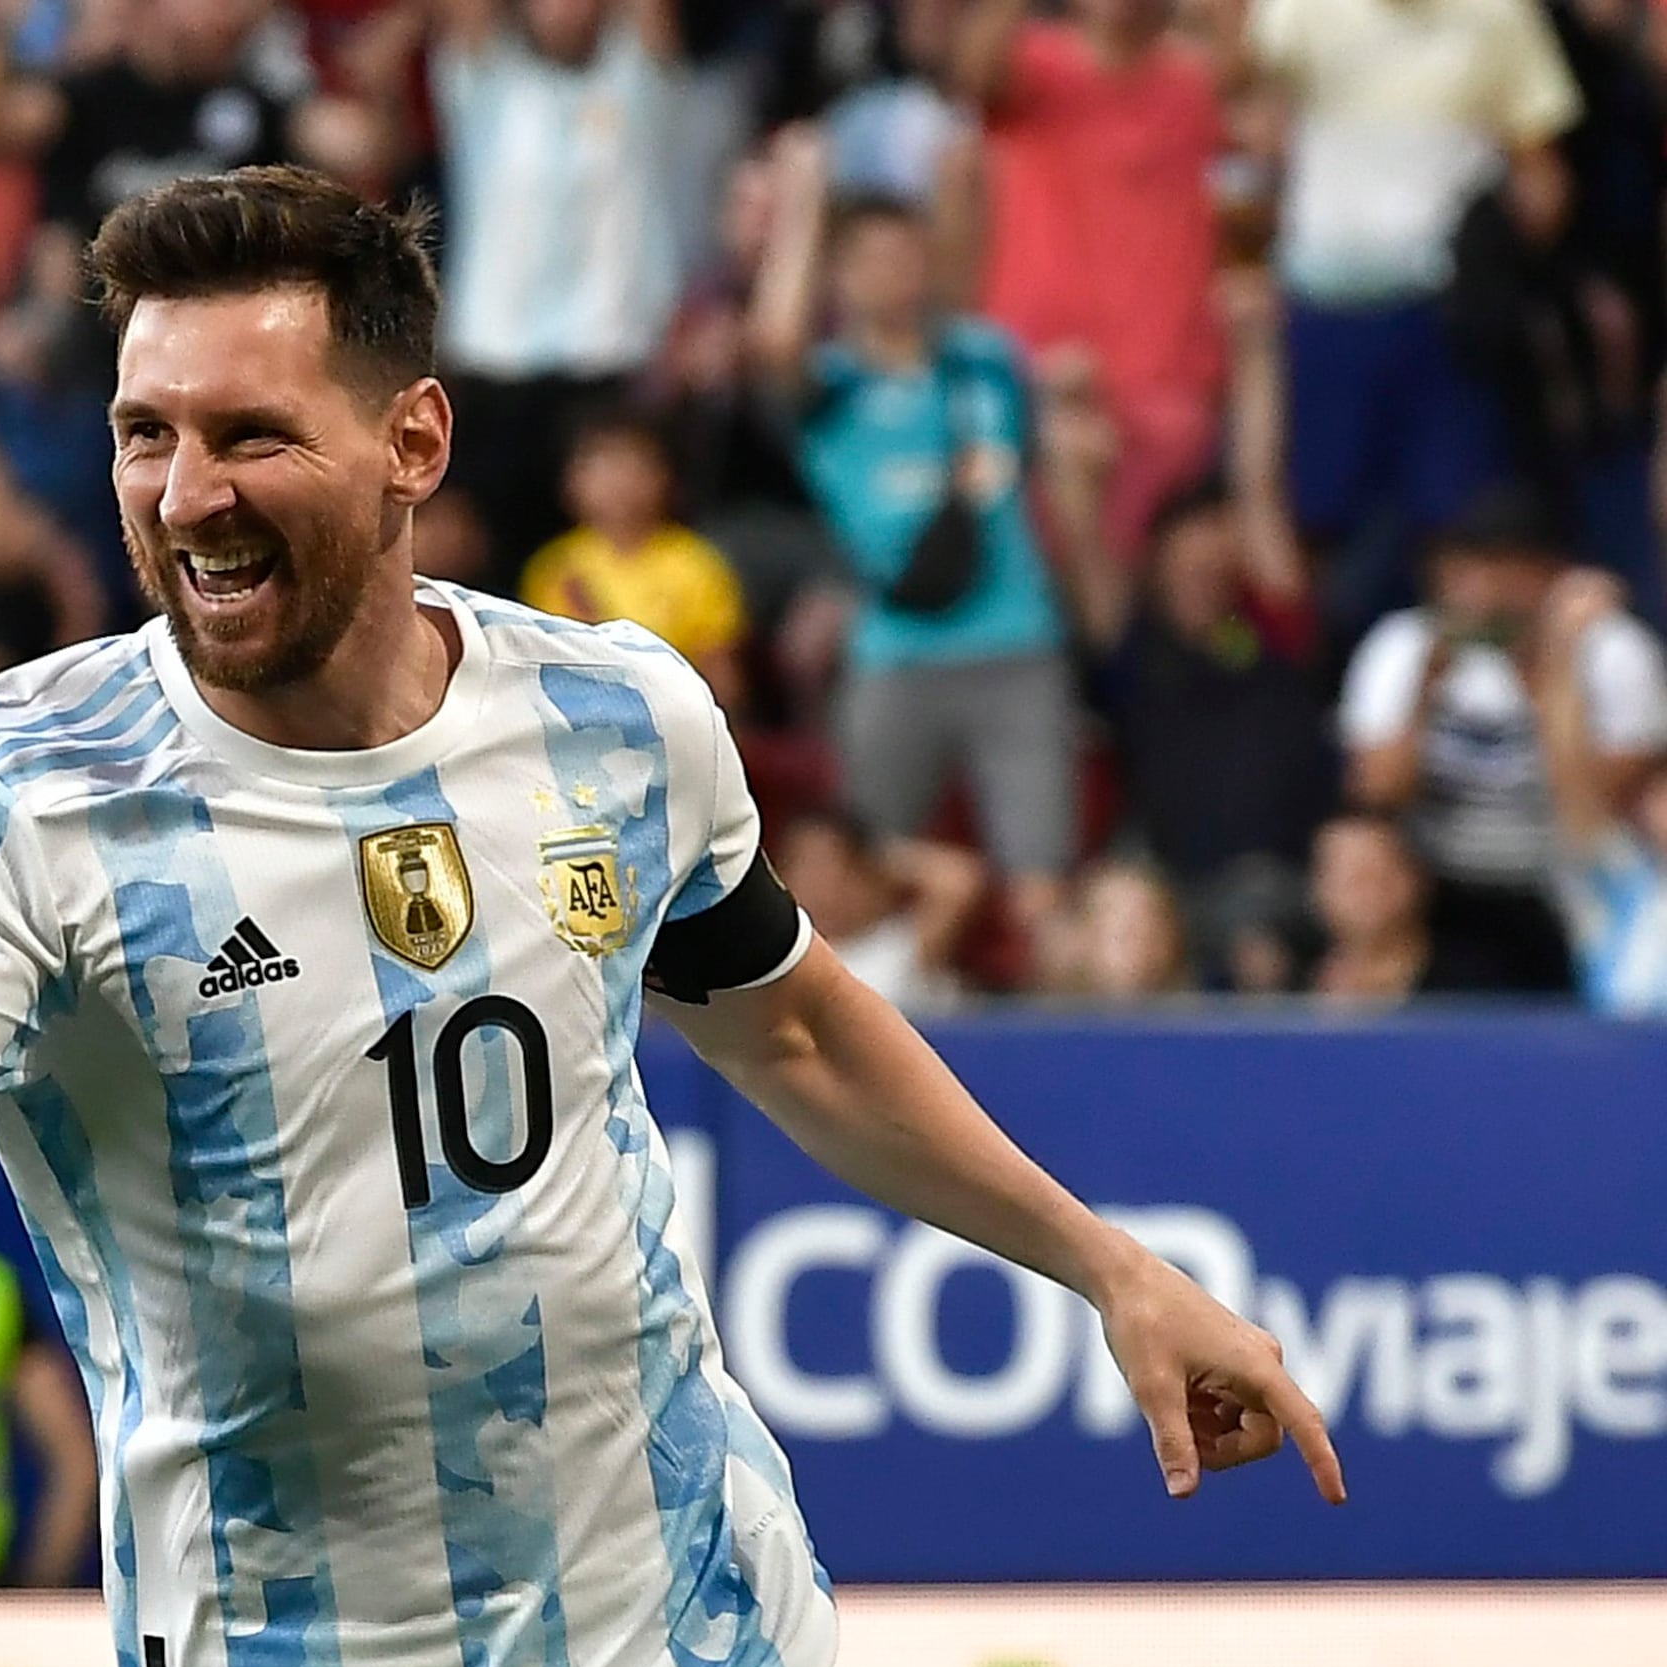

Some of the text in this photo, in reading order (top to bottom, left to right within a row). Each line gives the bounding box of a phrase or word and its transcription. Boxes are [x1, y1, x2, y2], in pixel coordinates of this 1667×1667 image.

[567, 861, 618, 921] AFA
[199, 958, 300, 998] adidas
[367, 994, 553, 1210] 10
